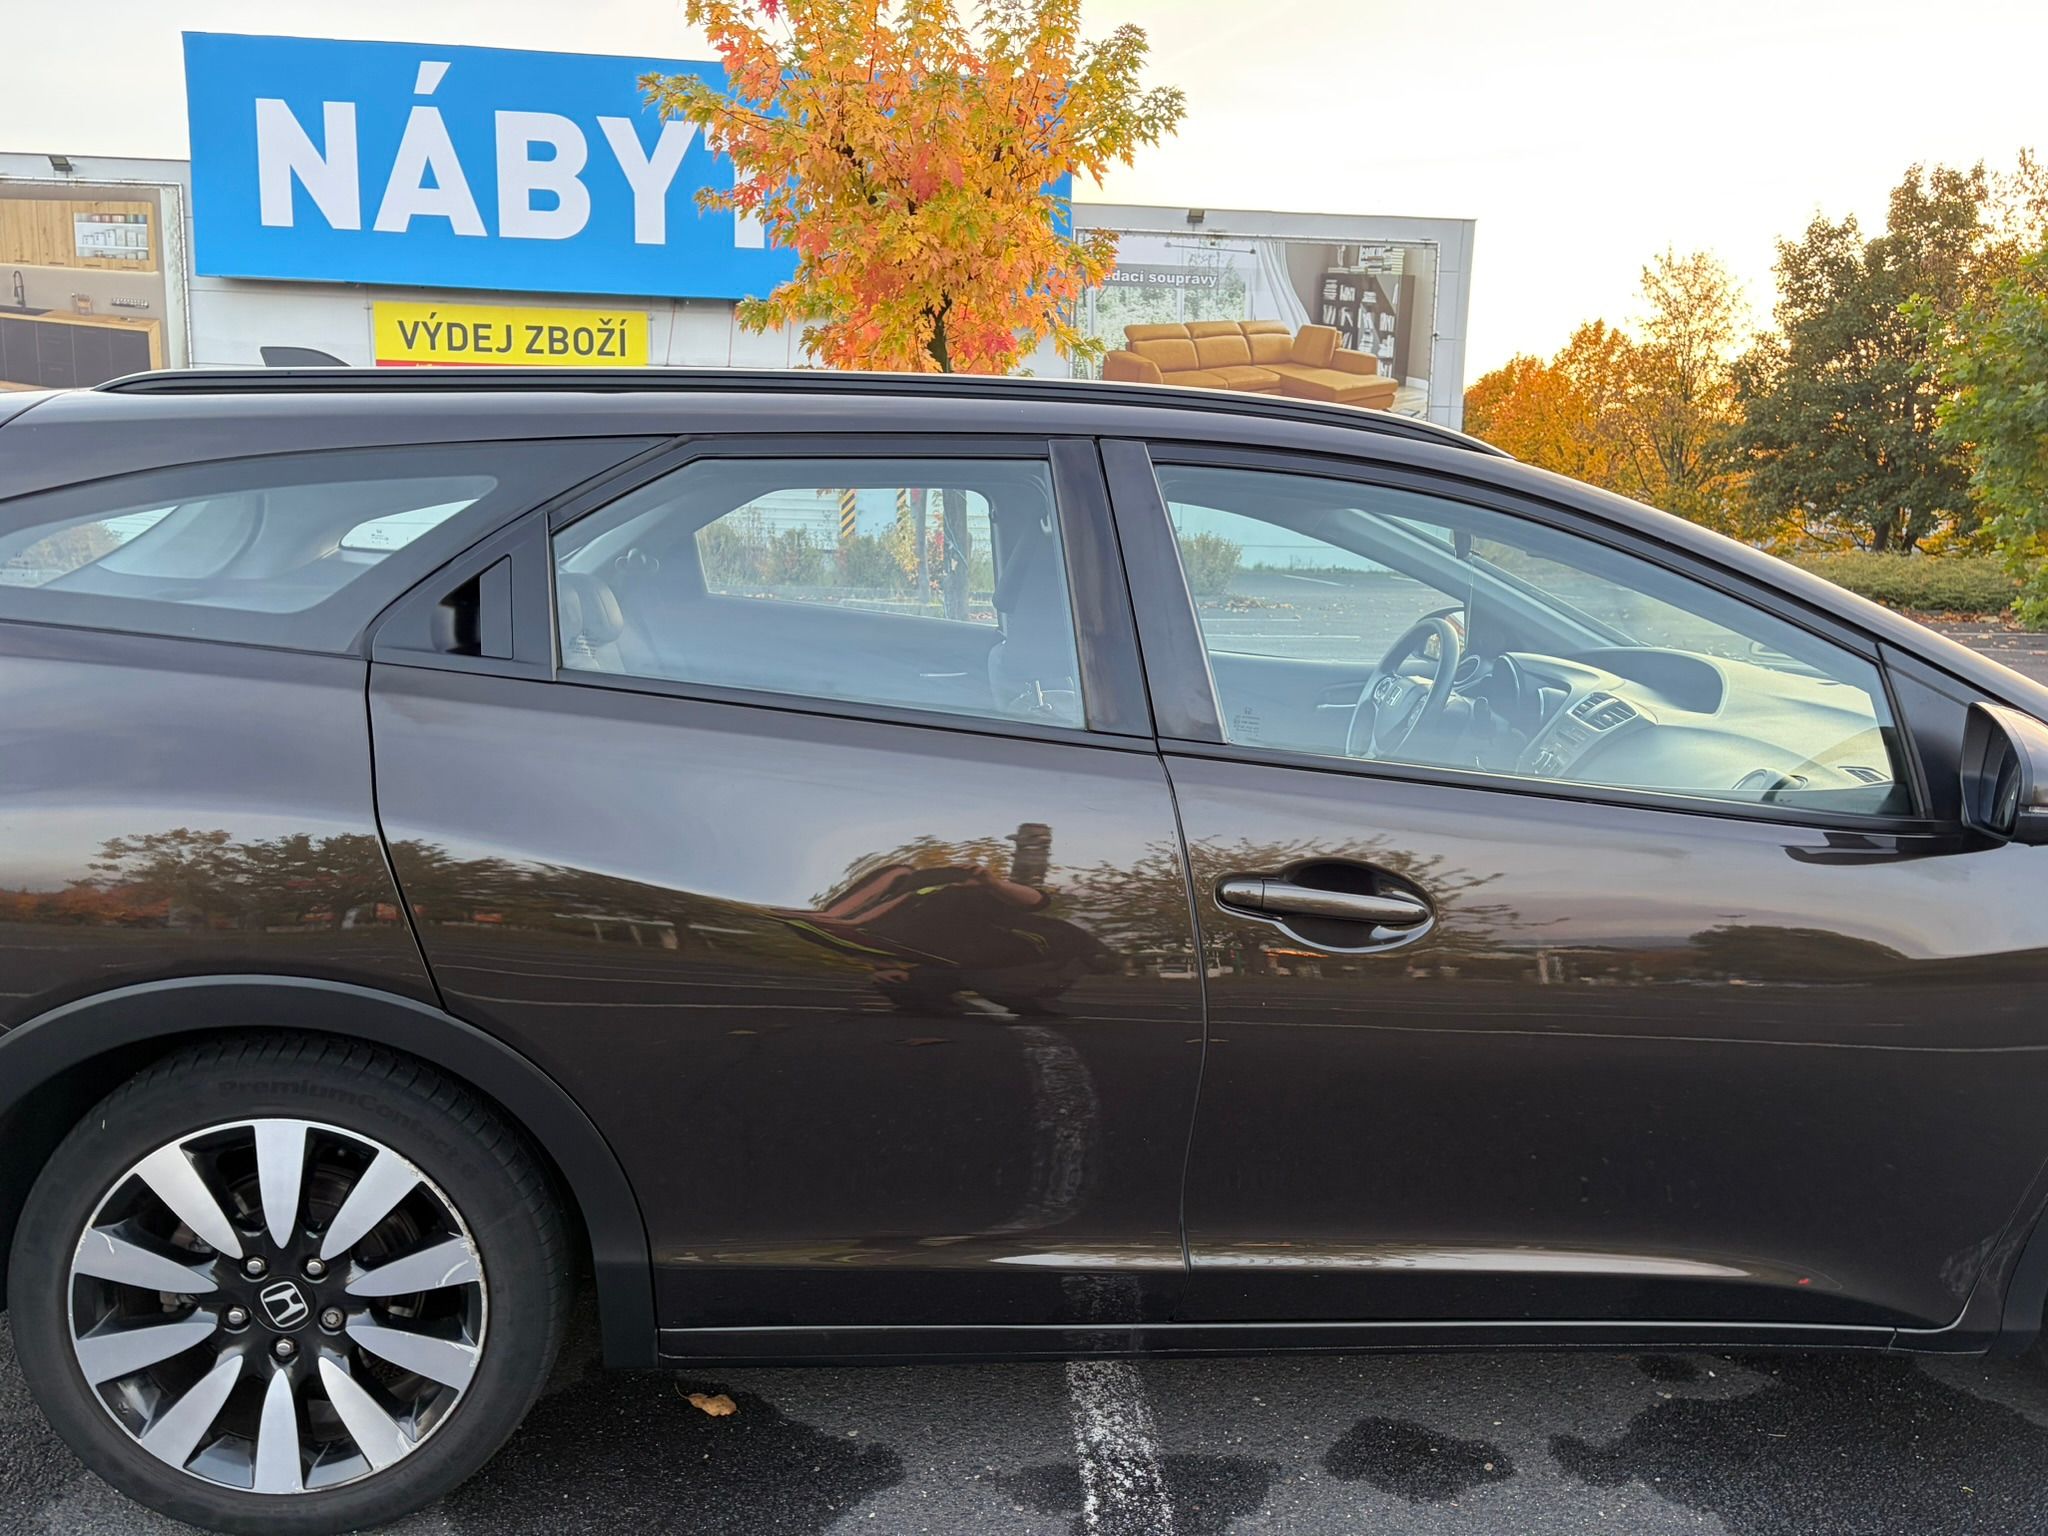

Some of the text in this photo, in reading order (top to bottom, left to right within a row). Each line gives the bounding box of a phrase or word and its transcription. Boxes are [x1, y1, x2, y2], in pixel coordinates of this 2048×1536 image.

[1148, 273, 1217, 287] soupravy
[397, 312, 627, 357] VÝDEJ ZBOŽÍ
